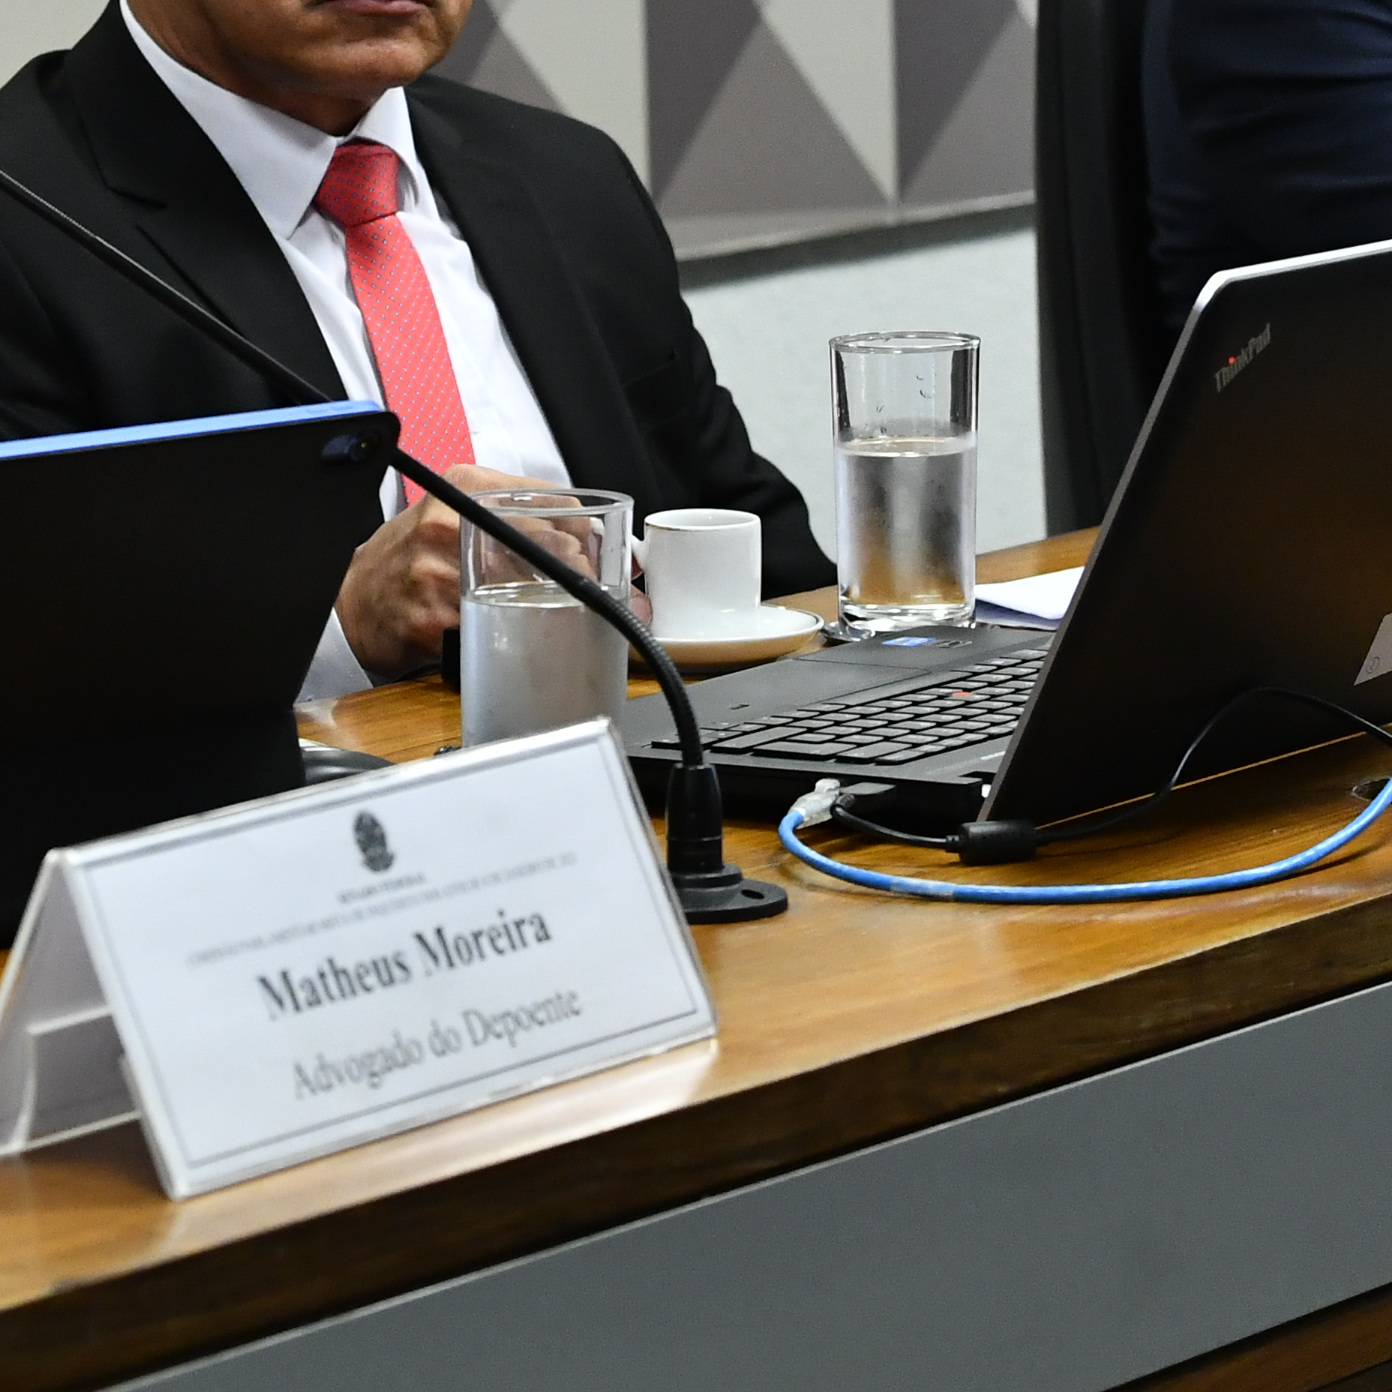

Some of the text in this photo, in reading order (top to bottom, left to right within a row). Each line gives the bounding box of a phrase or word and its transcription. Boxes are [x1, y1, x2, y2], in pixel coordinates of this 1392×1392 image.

[1214, 323, 1270, 393] ThinkPad
[258, 957, 412, 1021] Matheus
[413, 909, 552, 977] Moreira
[292, 990, 583, 1101] Advogado do Depoente
